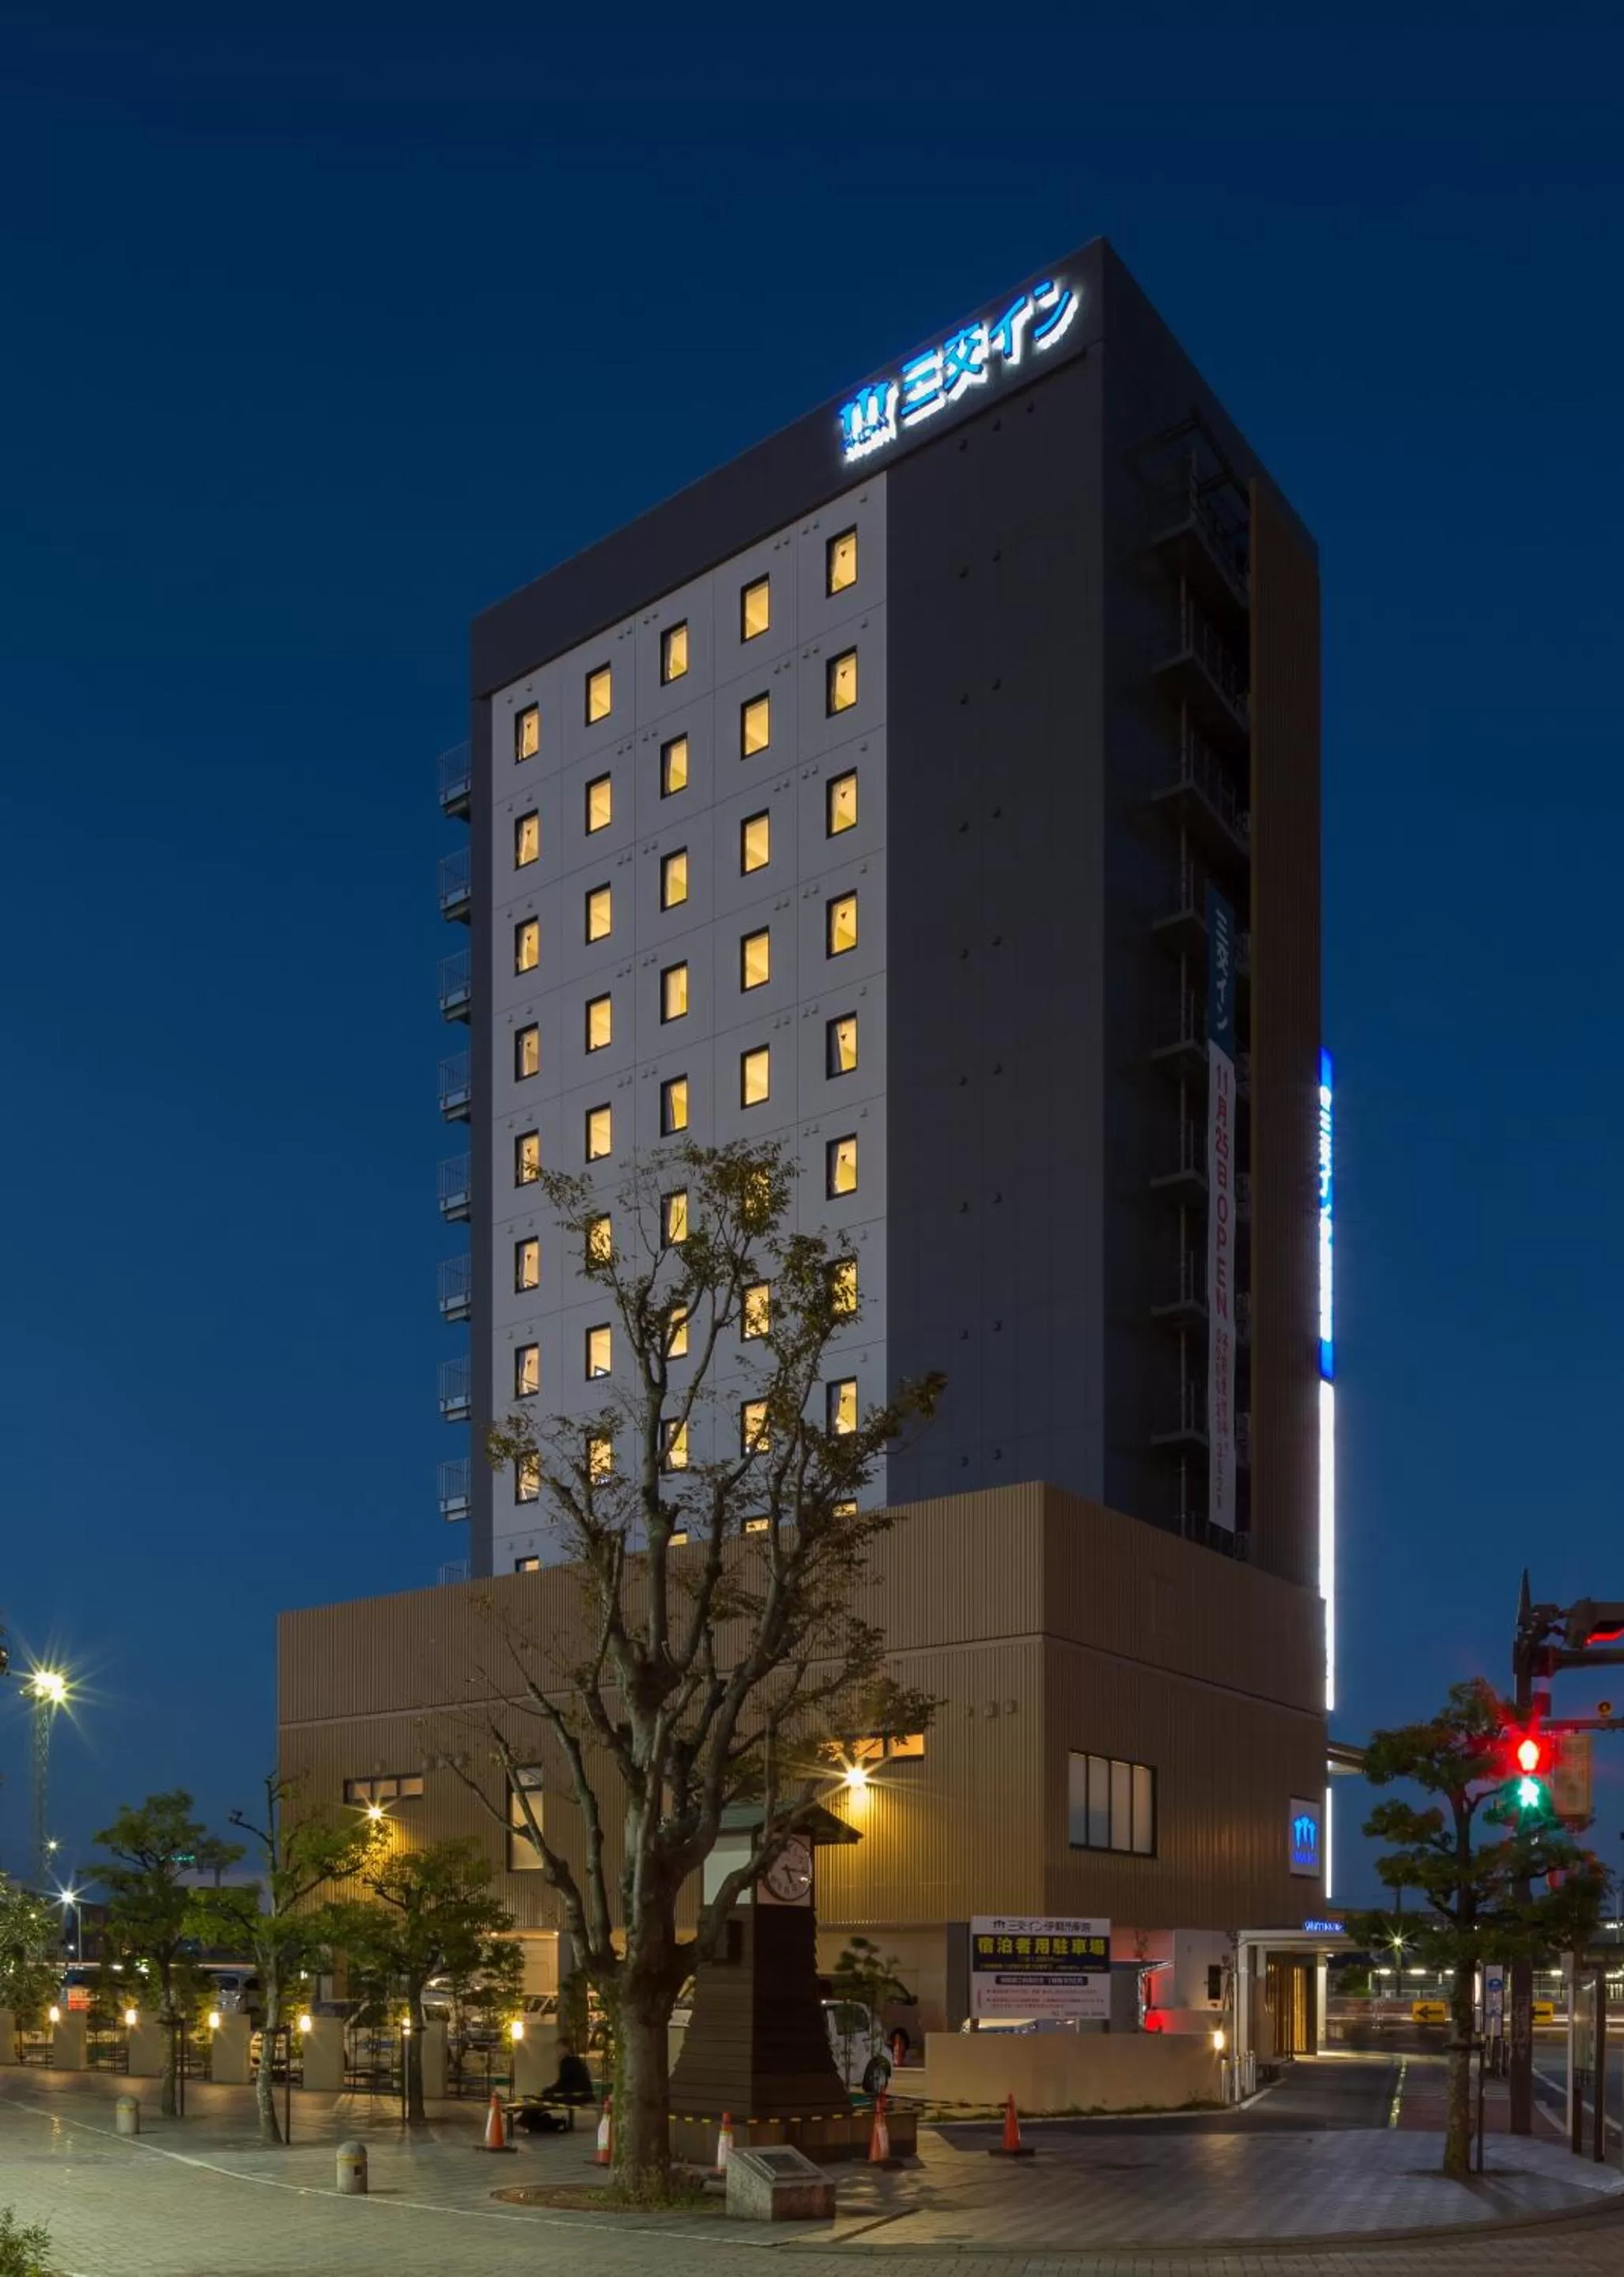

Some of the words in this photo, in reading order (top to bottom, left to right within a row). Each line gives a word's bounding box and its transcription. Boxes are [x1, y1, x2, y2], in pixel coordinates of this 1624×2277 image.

[900, 279, 1078, 424] 三交イン
[978, 1937, 1105, 1955] 宿泊者用駐車場
